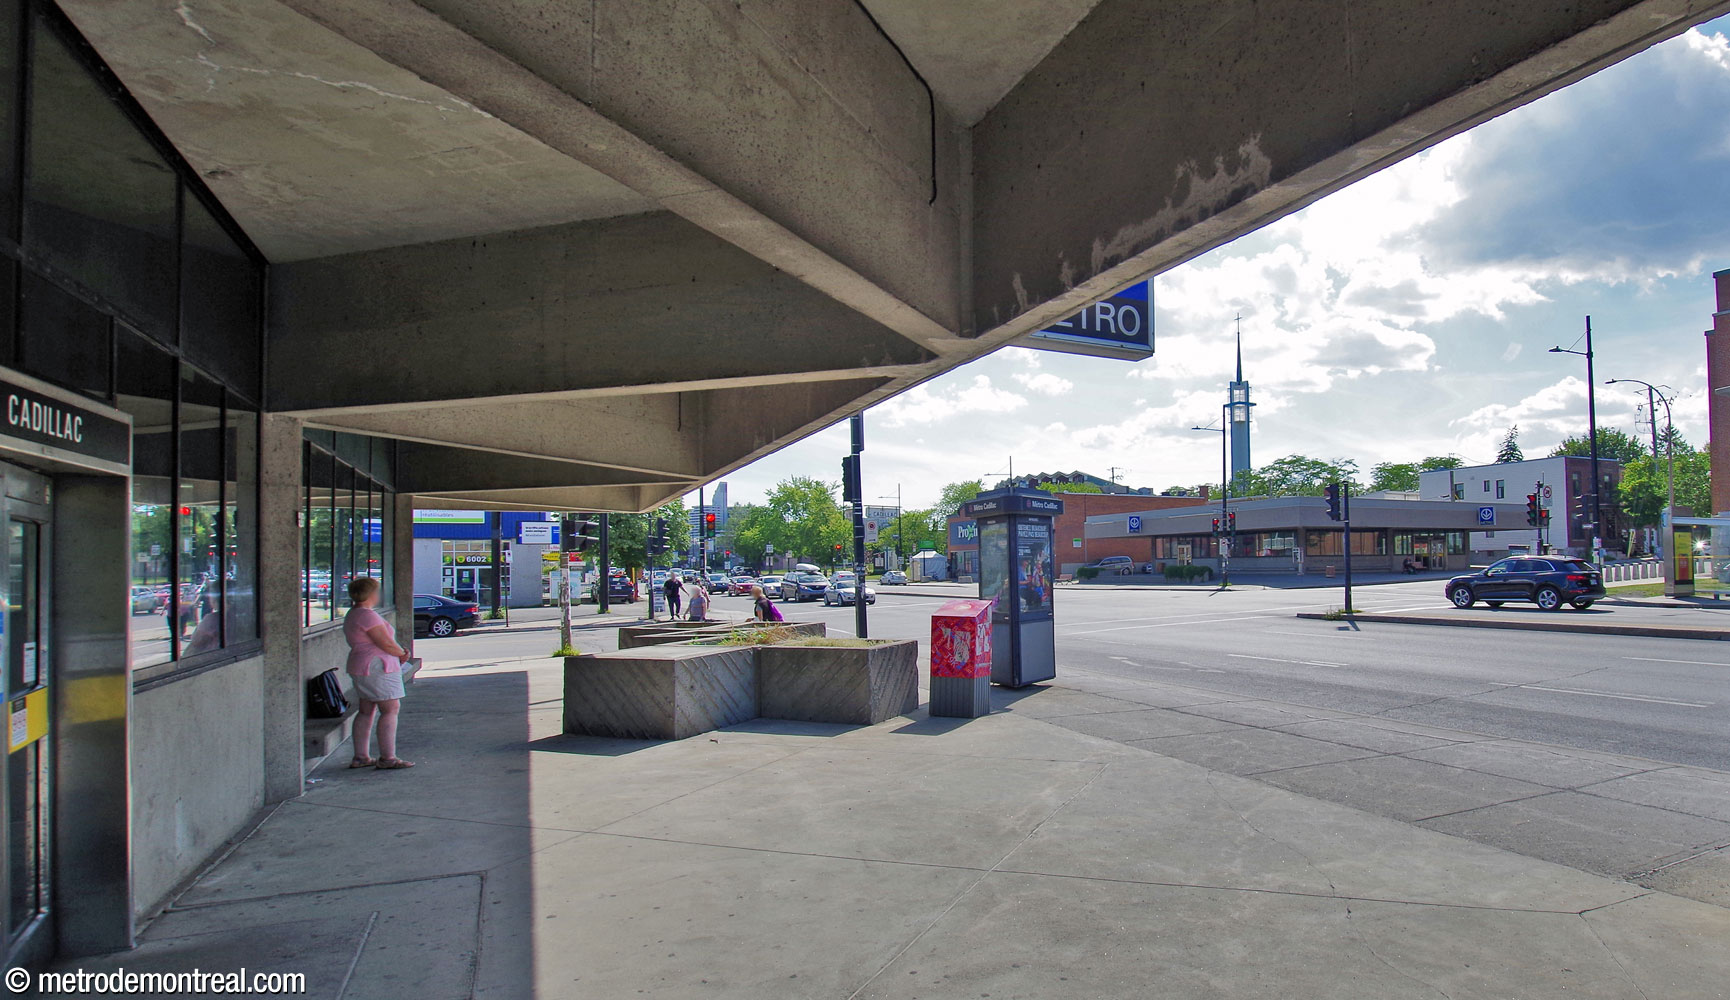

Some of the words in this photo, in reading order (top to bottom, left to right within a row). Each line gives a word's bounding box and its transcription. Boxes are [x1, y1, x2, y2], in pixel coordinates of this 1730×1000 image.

[1055, 301, 1140, 336] TRO
[8, 394, 83, 443] CADILLAC
[1044, 501, 1058, 510] Cadillac
